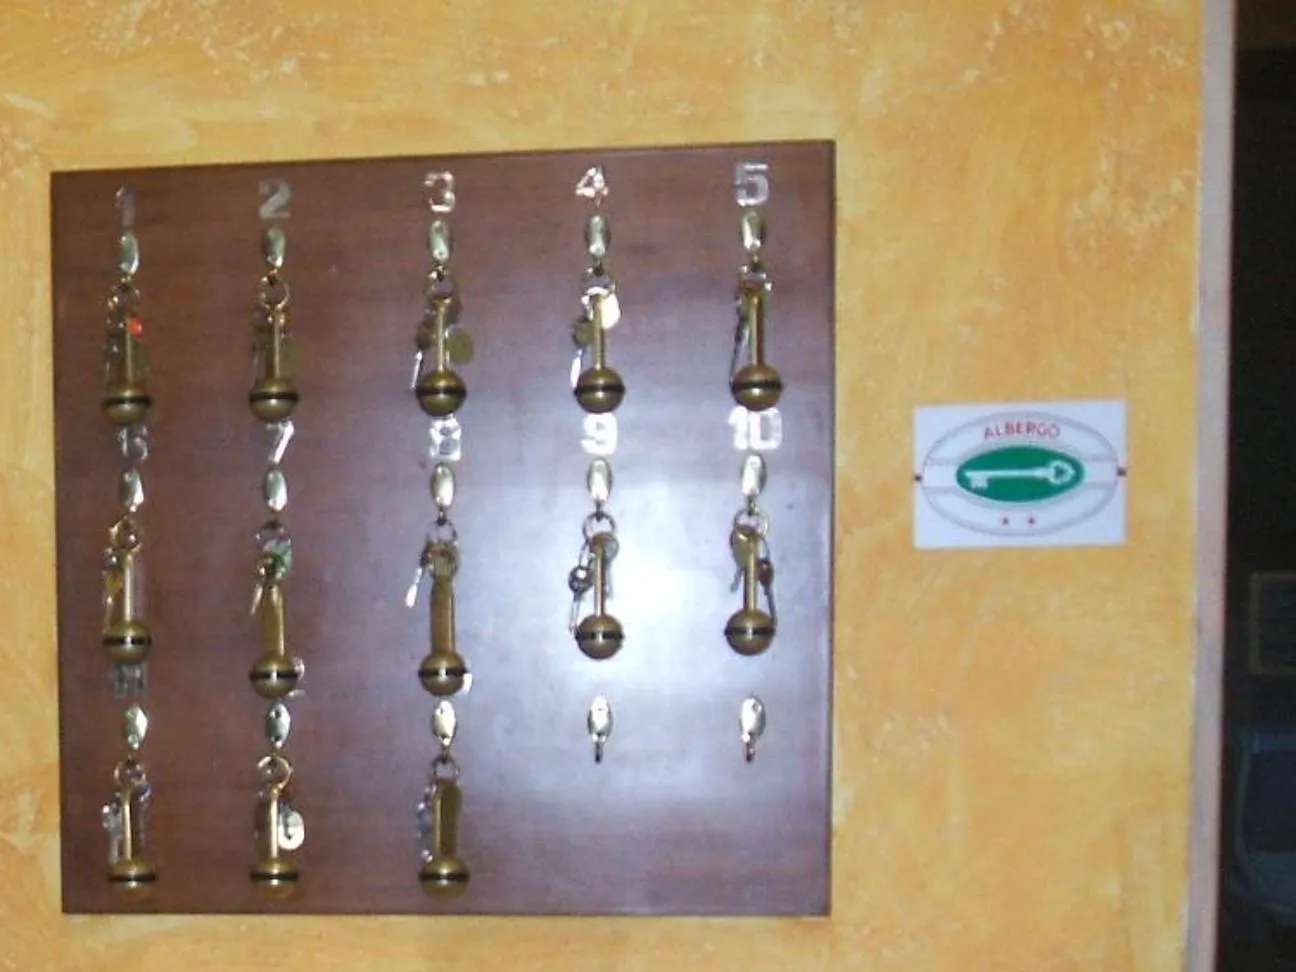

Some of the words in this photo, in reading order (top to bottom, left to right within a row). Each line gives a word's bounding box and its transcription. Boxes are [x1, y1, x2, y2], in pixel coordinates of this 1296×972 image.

[259, 180, 292, 220] 2
[423, 171, 456, 213] 3
[576, 165, 609, 206] 4
[735, 163, 771, 207] 5
[266, 420, 297, 464] 7
[429, 416, 462, 462] 8
[580, 413, 619, 456] 9
[729, 407, 784, 451] 10
[983, 421, 1062, 441] ALBERGO
